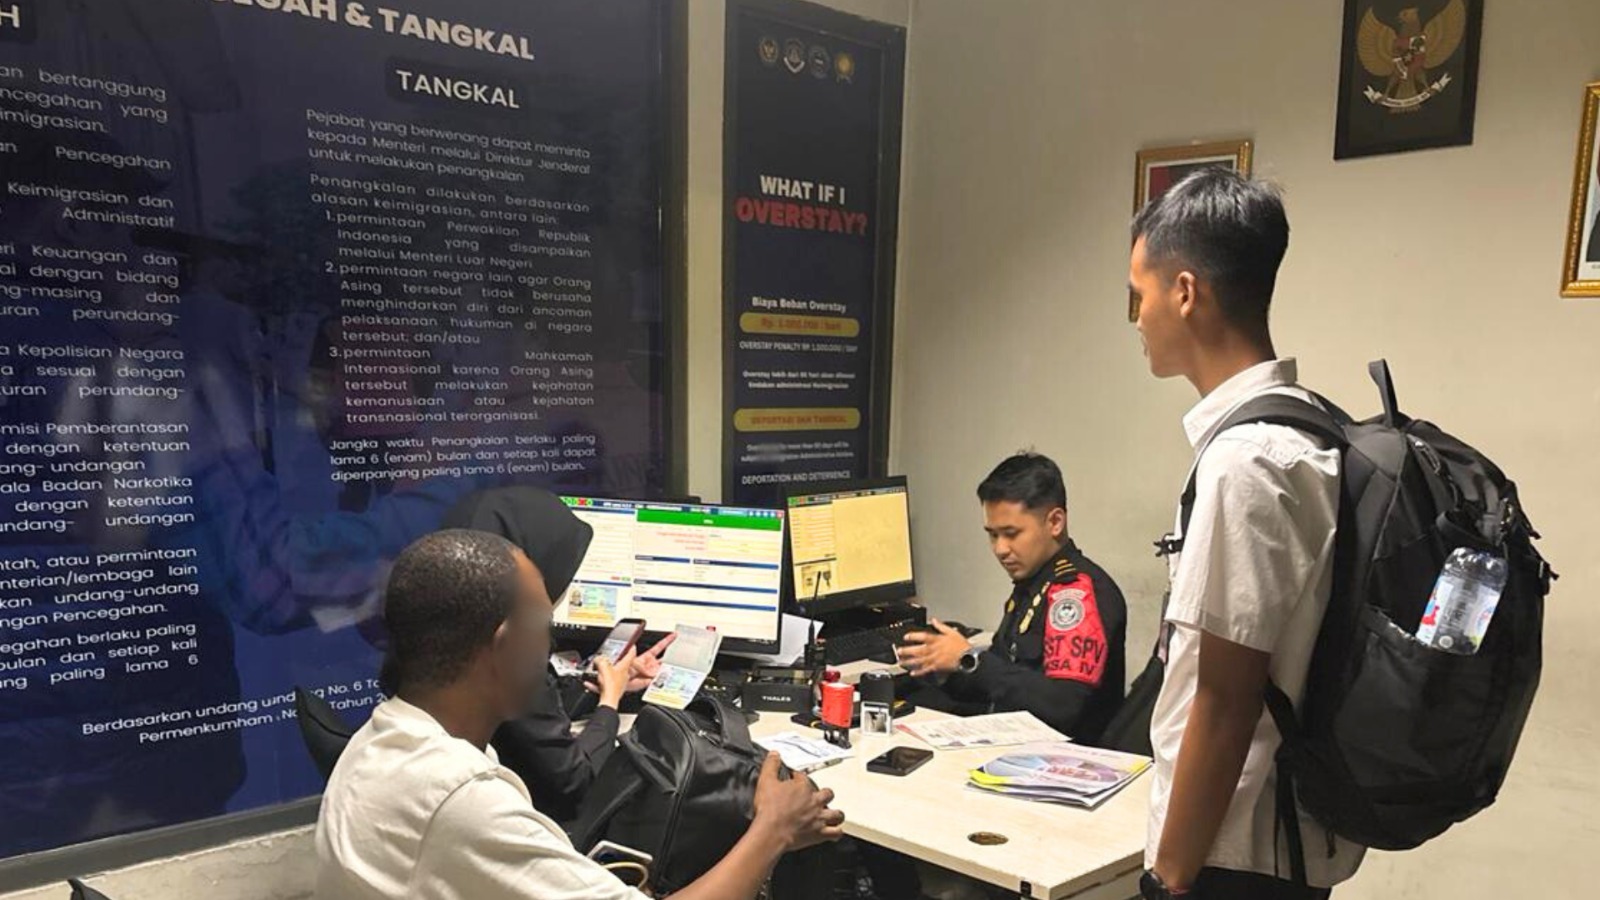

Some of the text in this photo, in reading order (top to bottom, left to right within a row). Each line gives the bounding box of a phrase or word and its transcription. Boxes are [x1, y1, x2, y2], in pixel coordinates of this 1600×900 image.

[345, 3, 534, 60] & TANGKAL
[39, 68, 167, 102] bertanggung
[396, 69, 519, 109] TANGKAL
[120, 103, 168, 123] yang
[307, 109, 590, 159] Pejabat yang berwenang dapat meminta
[55, 146, 172, 170] Pencegahan
[308, 128, 590, 175] kepada Menteri melalui Direktur Jenderal
[309, 148, 524, 183] untuk melakukan penangkalan
[7, 182, 174, 208] Keimigrasian dan
[310, 173, 590, 213] Penangkalan dilakukan berdasarkan
[760, 175, 845, 205] WHAT IF I
[62, 207, 176, 228] Administratif
[311, 192, 368, 207] alasan
[480, 209, 527, 222] antara
[735, 198, 867, 235] OVERSTAY?
[447, 221, 591, 243] Perwakilan Republik
[338, 230, 591, 258] Indonesia yang disampaikan
[32, 245, 178, 266] Keuangan dan
[339, 246, 532, 270] melalui Menteri Luar Negeri
[29, 265, 179, 288] dengan bidang
[339, 263, 592, 290] permintaan negara lain agar Orang
[145, 291, 180, 303] dan
[341, 281, 592, 303] Asing tersebut tidak berusaha
[341, 297, 592, 318] menghindarkan diri dari ancaman
[752, 296, 846, 314] Biaya Beban Overstay
[72, 308, 180, 326] perundang-
[342, 314, 592, 334] pelaksanaan hukuman di negara
[414, 332, 480, 344] dan/atau
[740, 340, 772, 350] OVERSTAY
[773, 342, 801, 351] PENALTY
[18, 344, 184, 362] Kepolisian Negara
[525, 351, 593, 362] Mahkamah
[36, 364, 96, 377] sesuai
[116, 365, 185, 381] dengan
[453, 364, 499, 376] karena
[511, 365, 550, 378] Orang
[561, 366, 594, 379] Asing
[78, 385, 185, 399] perundang-
[345, 380, 594, 393] tersebut melakukan kejahatan
[346, 395, 594, 407] kemanusiaan atau kejahatan
[347, 410, 447, 423] transnasional
[46, 422, 189, 435] Pemberantasan
[6, 441, 190, 457] dengan ketentuan
[330, 434, 596, 451] Jangka waktu Penangkalan berlaku paling
[331, 446, 596, 466] lama 6 (enam) bulan dan setiap kali dapat
[51, 460, 146, 474] undangan
[331, 467, 419, 482] diperpanjang
[423, 465, 460, 478] paling
[464, 464, 494, 475] lama
[497, 463, 504, 474] 6
[508, 461, 549, 474] (enam)
[42, 479, 103, 492] Badan
[113, 476, 193, 490] Narkotika
[742, 472, 807, 485] DEPORTATION AND
[15, 495, 194, 514] dengan ketentuan
[105, 512, 195, 527] undangan
[46, 548, 197, 568] atau permintaan
[168, 565, 198, 576] lain
[54, 582, 199, 604] undang-undang
[53, 602, 168, 623] Pencegahan.
[77, 630, 141, 645] berlaku
[145, 623, 196, 639] paling
[59, 638, 197, 664] dan setiap kali
[1071, 635, 1105, 664] SPV
[50, 654, 199, 685] paling lama 6
[82, 709, 192, 735] Berdasarkan
[194, 698, 258, 718] undang
[353, 680, 362, 691] 6
[139, 694, 373, 744] Permenkumham Tahun
